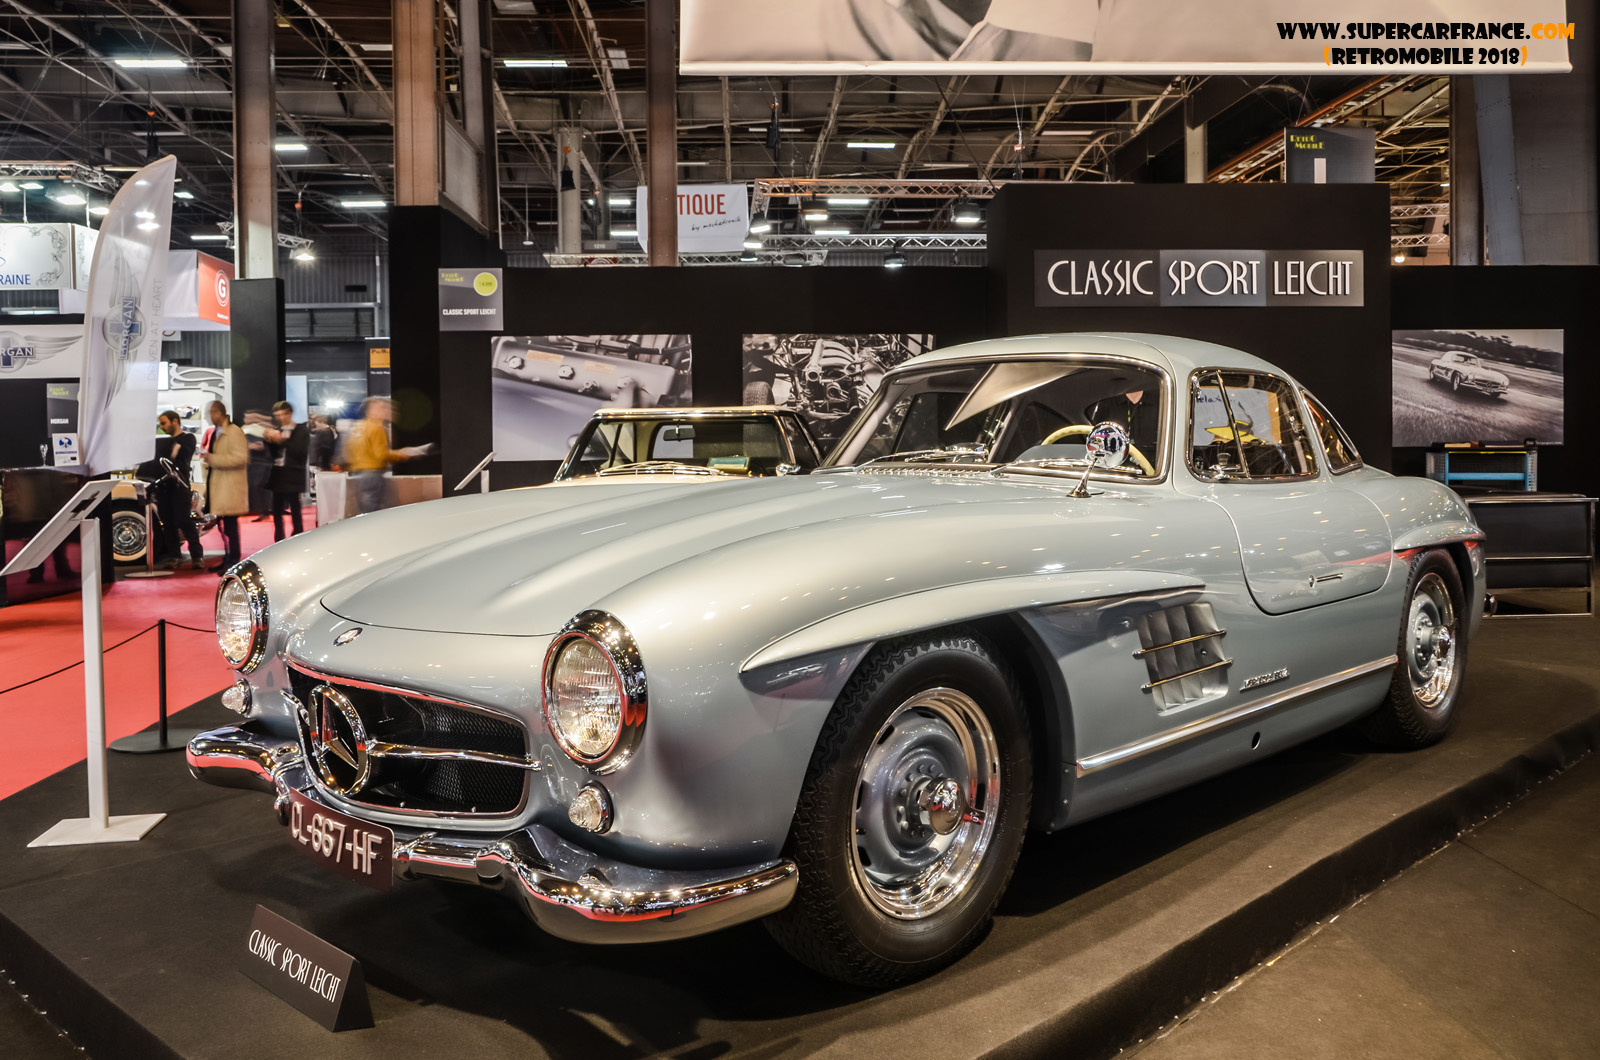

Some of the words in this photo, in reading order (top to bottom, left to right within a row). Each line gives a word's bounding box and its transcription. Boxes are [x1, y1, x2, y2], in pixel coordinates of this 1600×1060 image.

[677, 194, 726, 215] TIQUE
[218, 278, 227, 298] G
[1047, 259, 1154, 296] CLASSIC
[1167, 259, 1261, 296] SPORT
[1273, 260, 1354, 295] LEICHT
[152, 278, 162, 317] HEART
[442, 308, 463, 316] CLASSIC
[464, 308, 479, 316] SPORT
[121, 300, 134, 357] MORGAN
[150, 319, 159, 336] AT
[147, 340, 158, 381] DRVEN
[291, 801, 384, 875] CL-667-HF
[249, 929, 282, 967] CLASSIC
[279, 947, 312, 985] SPORT
[309, 965, 341, 1003] LEICHT
